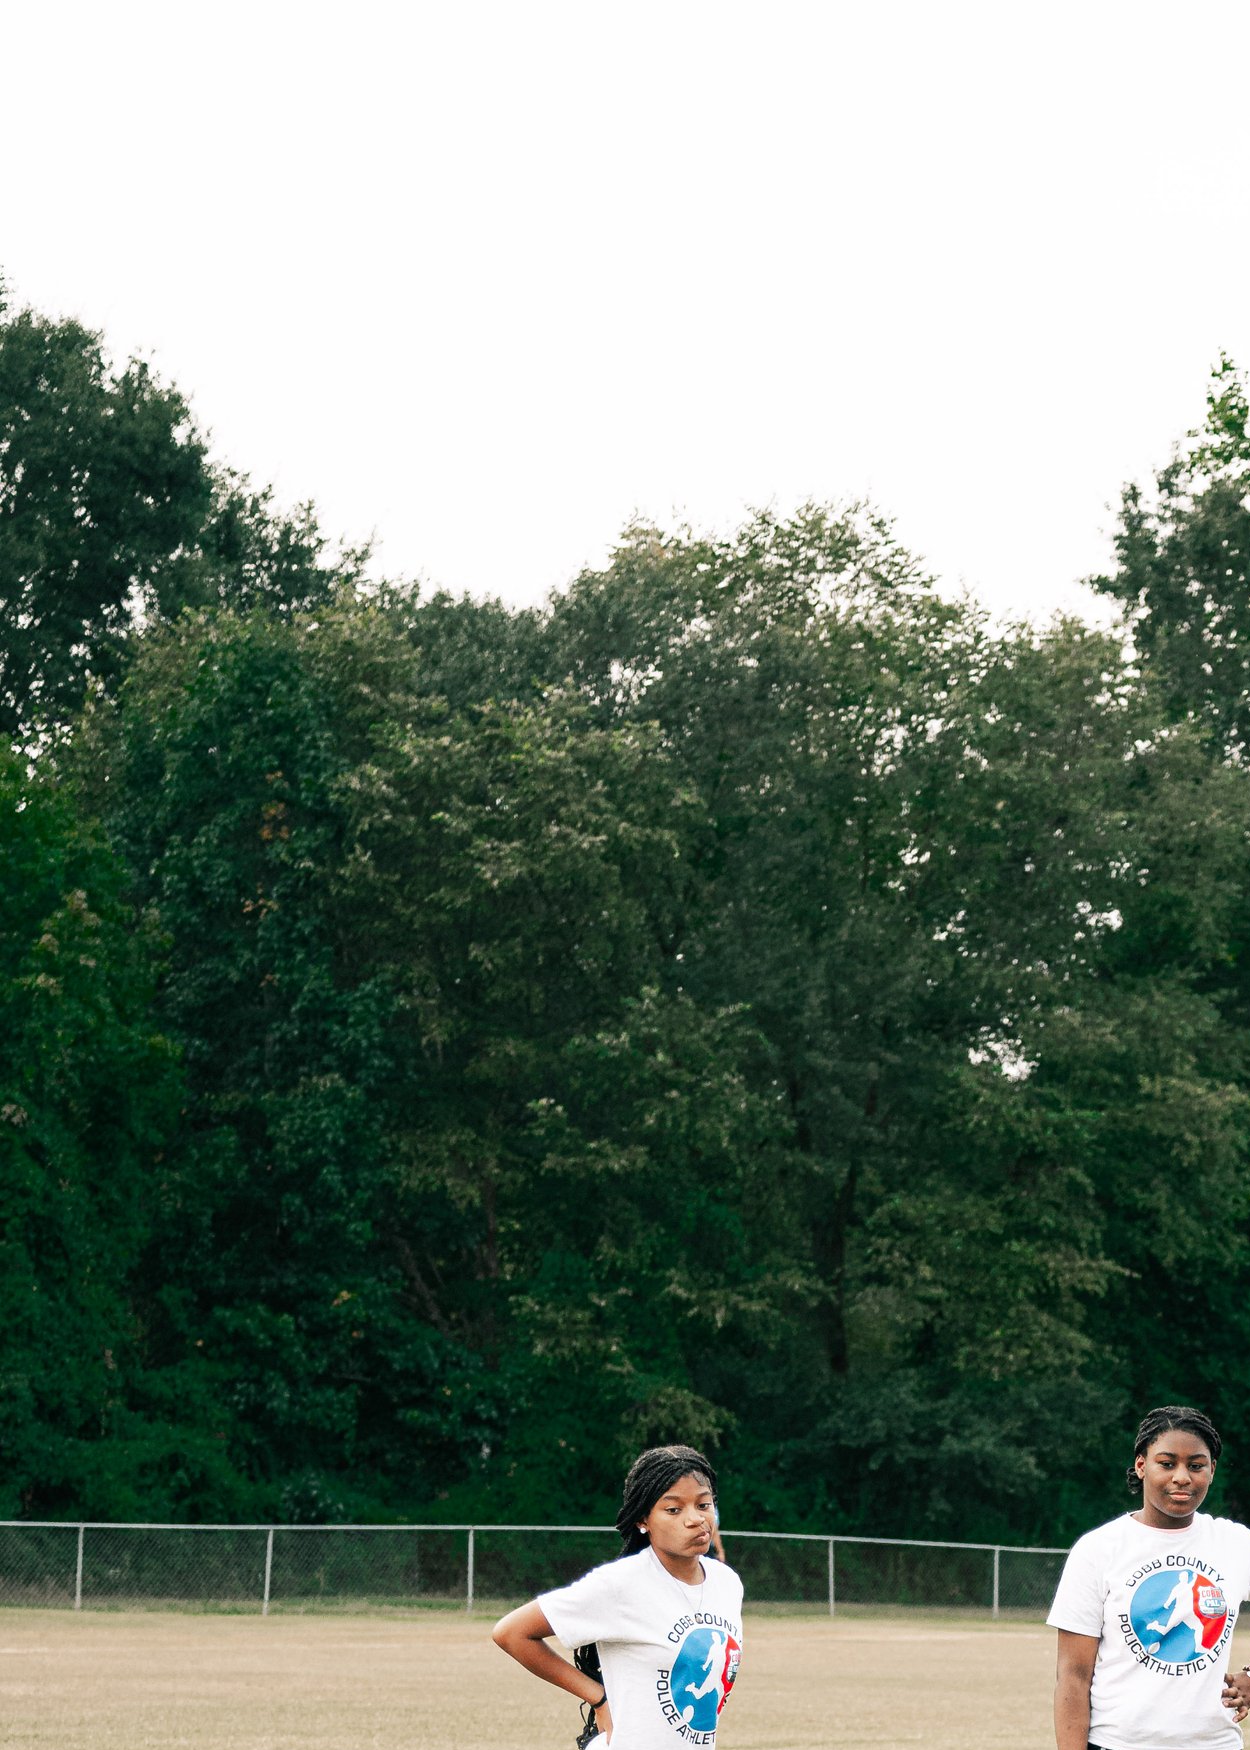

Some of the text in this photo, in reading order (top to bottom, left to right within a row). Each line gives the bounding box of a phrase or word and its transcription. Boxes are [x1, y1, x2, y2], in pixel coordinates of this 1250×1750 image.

[1126, 1555, 1224, 1587] COBB COUNTY
[668, 1612, 740, 1643] COBB COUNT
[1139, 1656, 1207, 1676] ATHLETIC
[1207, 1609, 1236, 1663] LEAGUE
[657, 1669, 716, 1745] POLICE ATHLET
